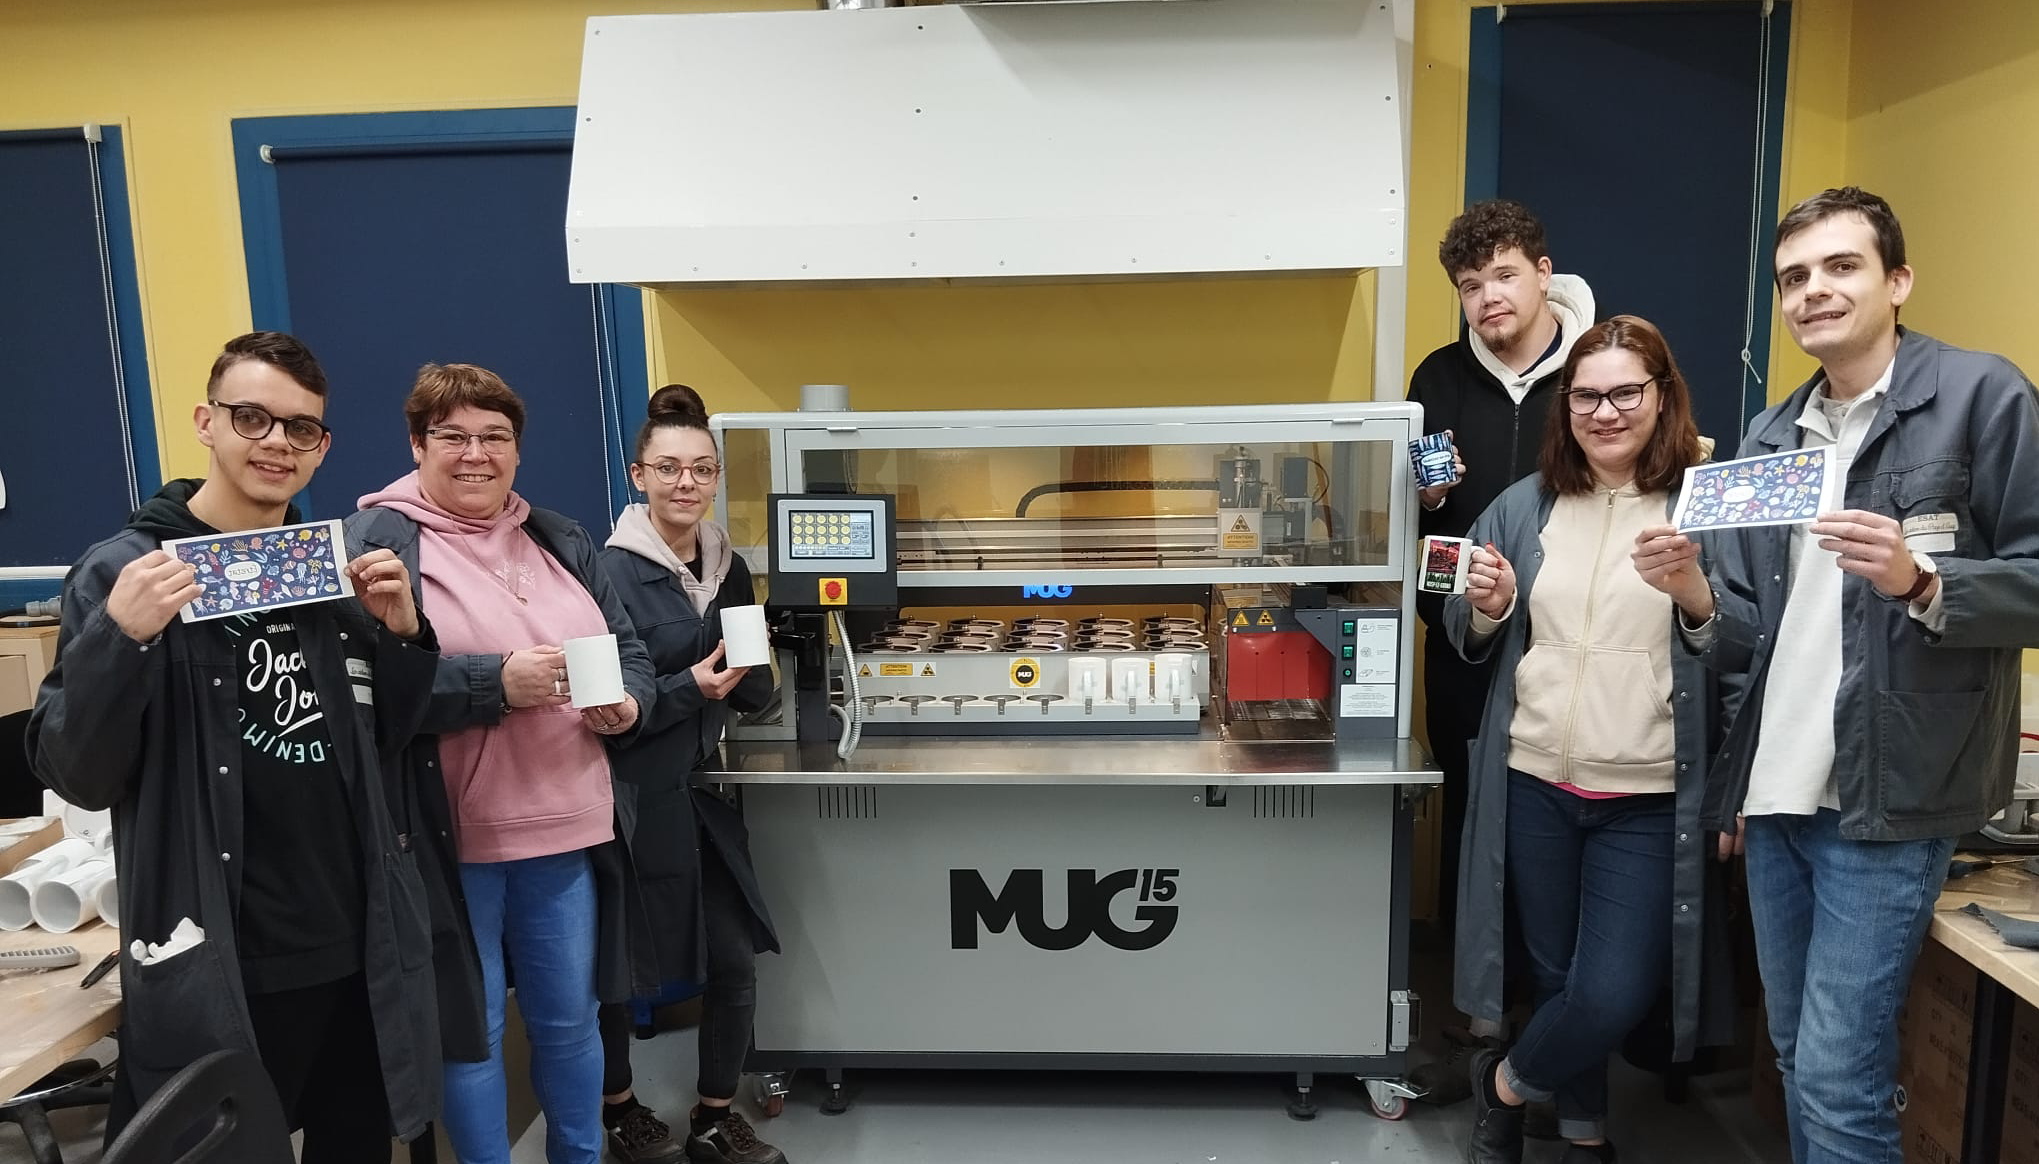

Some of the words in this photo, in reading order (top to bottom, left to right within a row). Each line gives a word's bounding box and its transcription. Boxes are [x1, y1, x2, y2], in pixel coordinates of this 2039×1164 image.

[1023, 585, 1072, 599] MUG
[242, 722, 326, 763] DENIM
[949, 868, 1179, 951] MUG
[1138, 868, 1180, 902] 15
